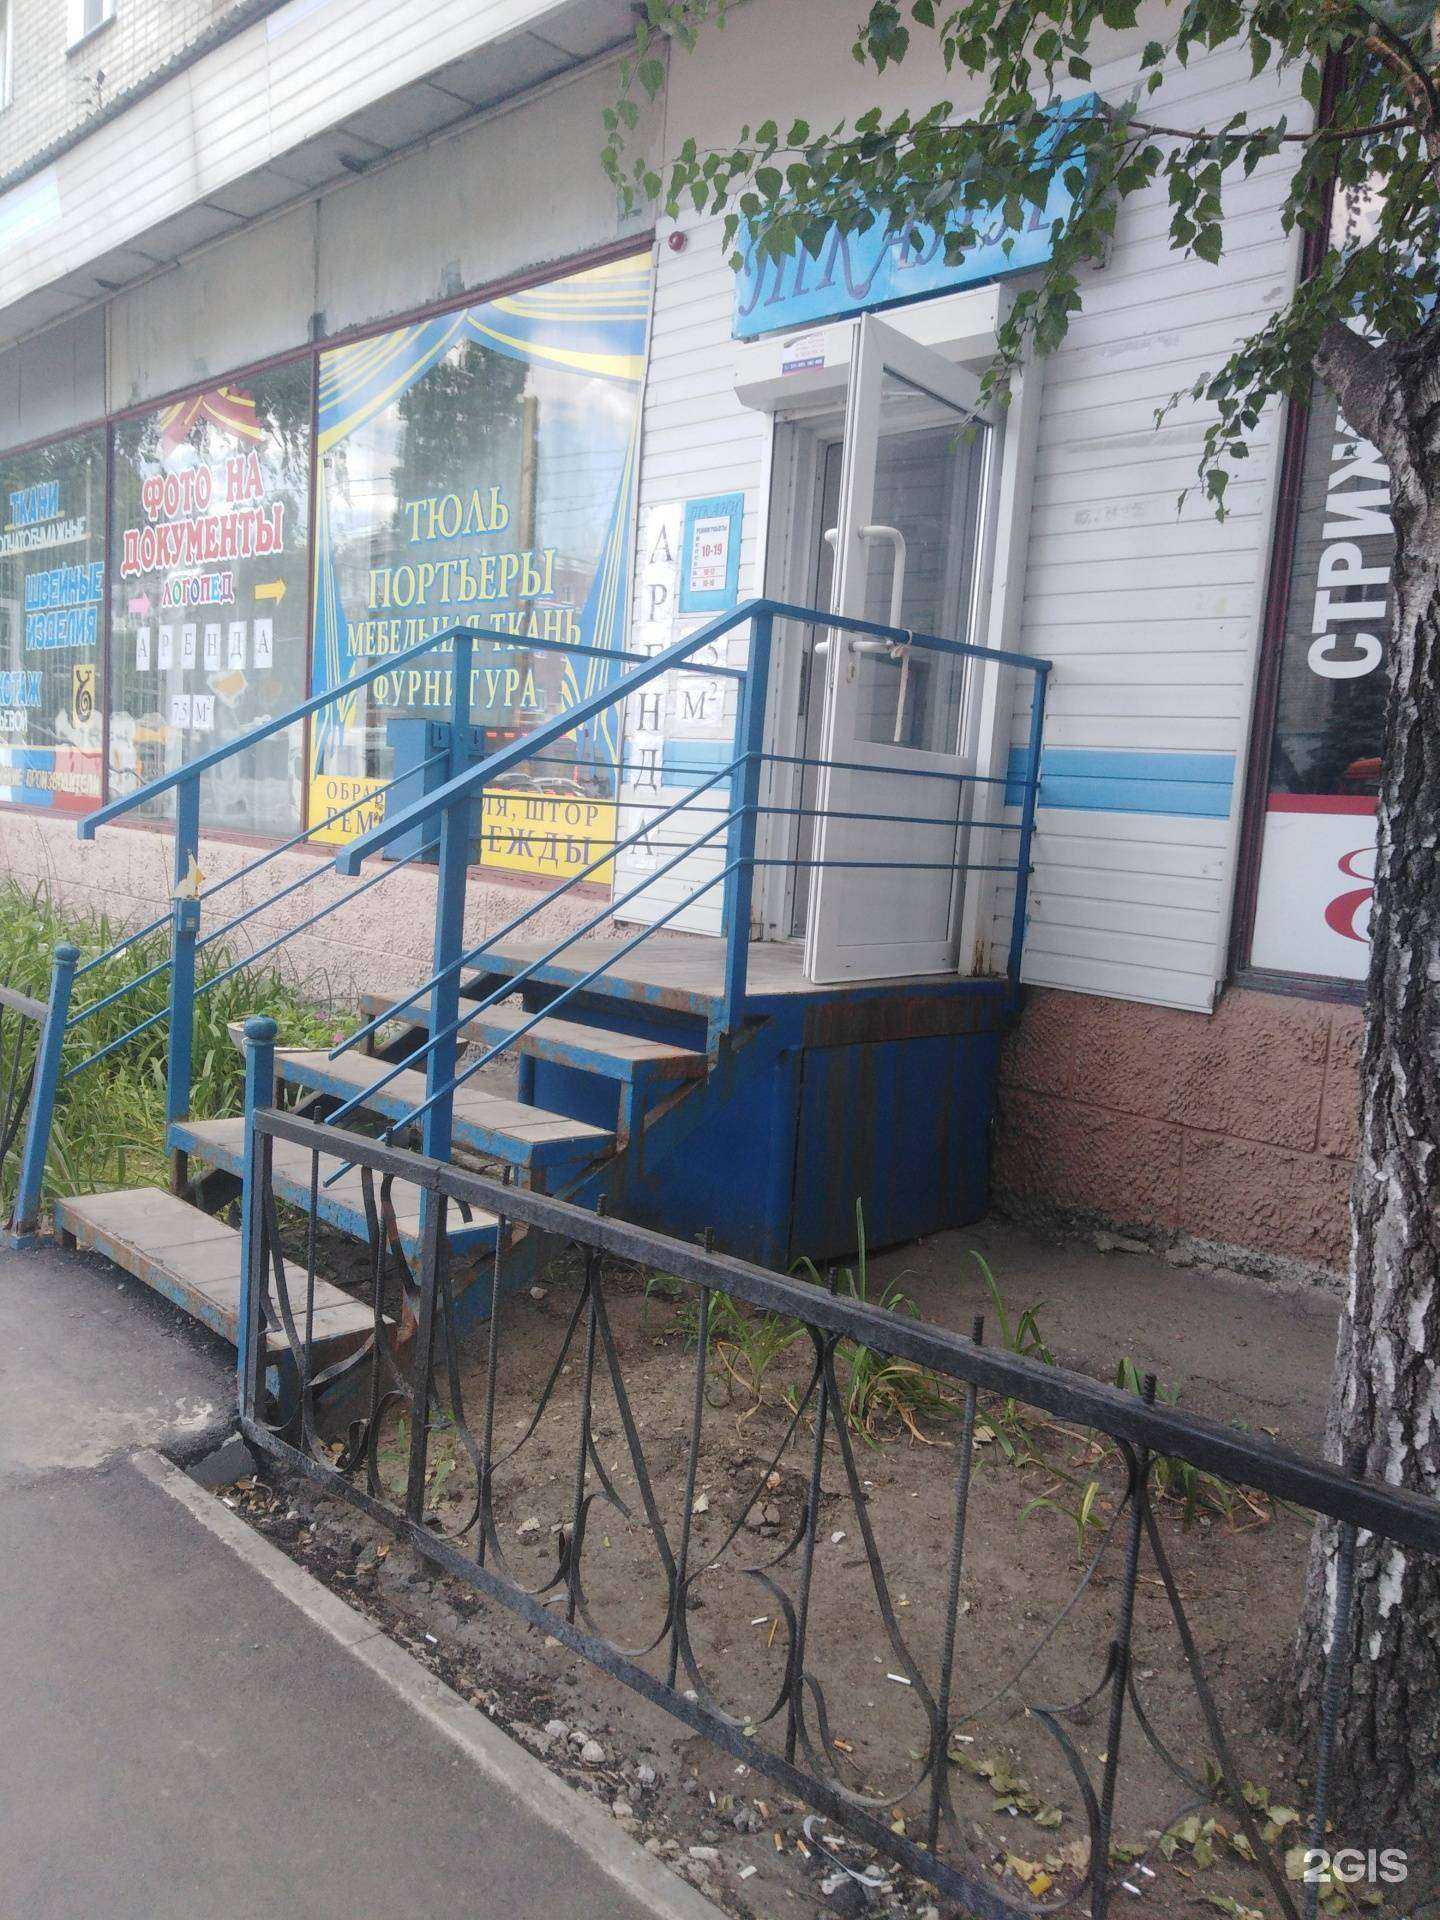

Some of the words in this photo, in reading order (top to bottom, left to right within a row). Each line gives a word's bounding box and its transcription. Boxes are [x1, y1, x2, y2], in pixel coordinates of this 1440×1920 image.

[10, 480, 60, 529] ТКАНИ
[142, 464, 212, 521] ФОТО
[225, 451, 266, 503] НА
[405, 486, 509, 543] ТЮЛЬ
[121, 501, 284, 580] ДОКУМЕНТЫ
[702, 543, 723, 557] 10-19
[25, 562, 105, 611] ШВЕЙНЫЕ
[162, 571, 234, 608] ЛОГОПЕД
[368, 548, 557, 609] ПОРТЬЕРЫ
[26, 606, 97, 650] ИЗДЕЛИЯ
[138, 630, 269, 658] АРЕНДА
[489, 608, 582, 652] ТКАНЬ
[0, 670, 43, 708] ОТАЖ
[326, 806, 384, 835] РЕМ
[525, 799, 599, 827] ШТОР
